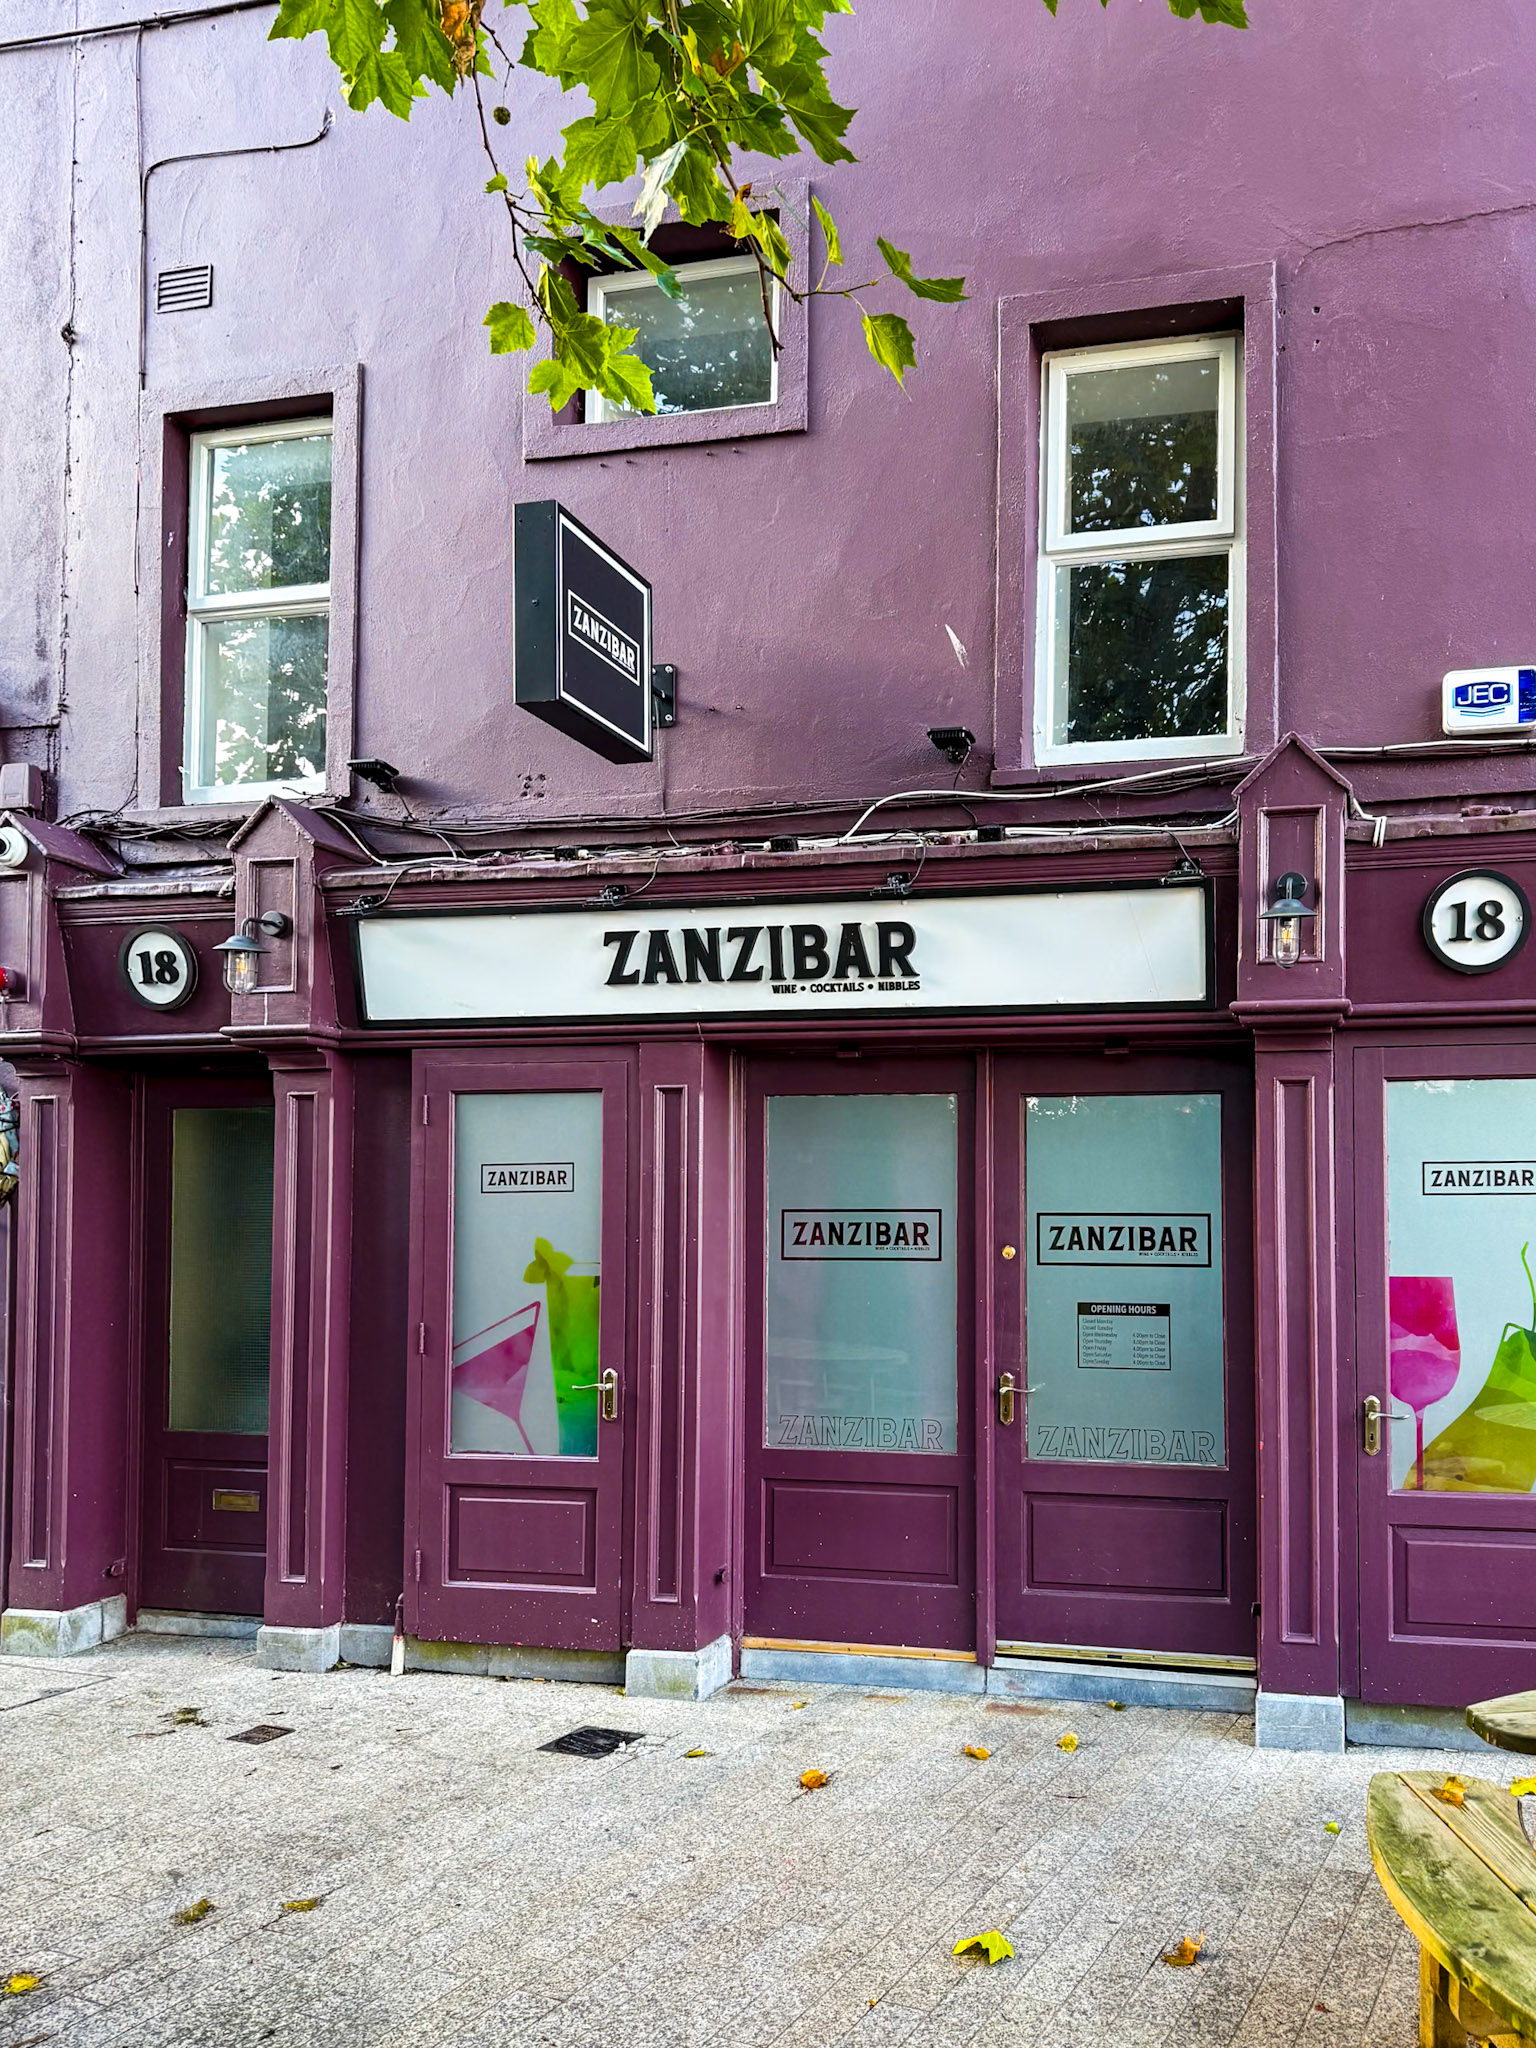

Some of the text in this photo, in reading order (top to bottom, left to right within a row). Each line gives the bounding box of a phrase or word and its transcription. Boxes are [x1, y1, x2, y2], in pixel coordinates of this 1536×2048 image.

[573, 604, 636, 672] ZANZIBAR
[1457, 683, 1508, 705] JEC
[1448, 899, 1505, 942] 18
[603, 921, 920, 985] ZANZIBAR
[136, 950, 180, 985] 18
[772, 980, 920, 994] WINE COCKTAILS NIBBLES
[487, 1170, 567, 1186] ZANZIBAR
[1431, 1169, 1534, 1187] ZANZIBAR
[792, 1221, 930, 1246] ZANZIBAR
[1048, 1225, 1199, 1251] ZANZIBAR
[1090, 1304, 1157, 1315] OPENING HOURS
[778, 1414, 943, 1450] ZANZIBAR
[1036, 1425, 1216, 1462] ZANZIBAR
